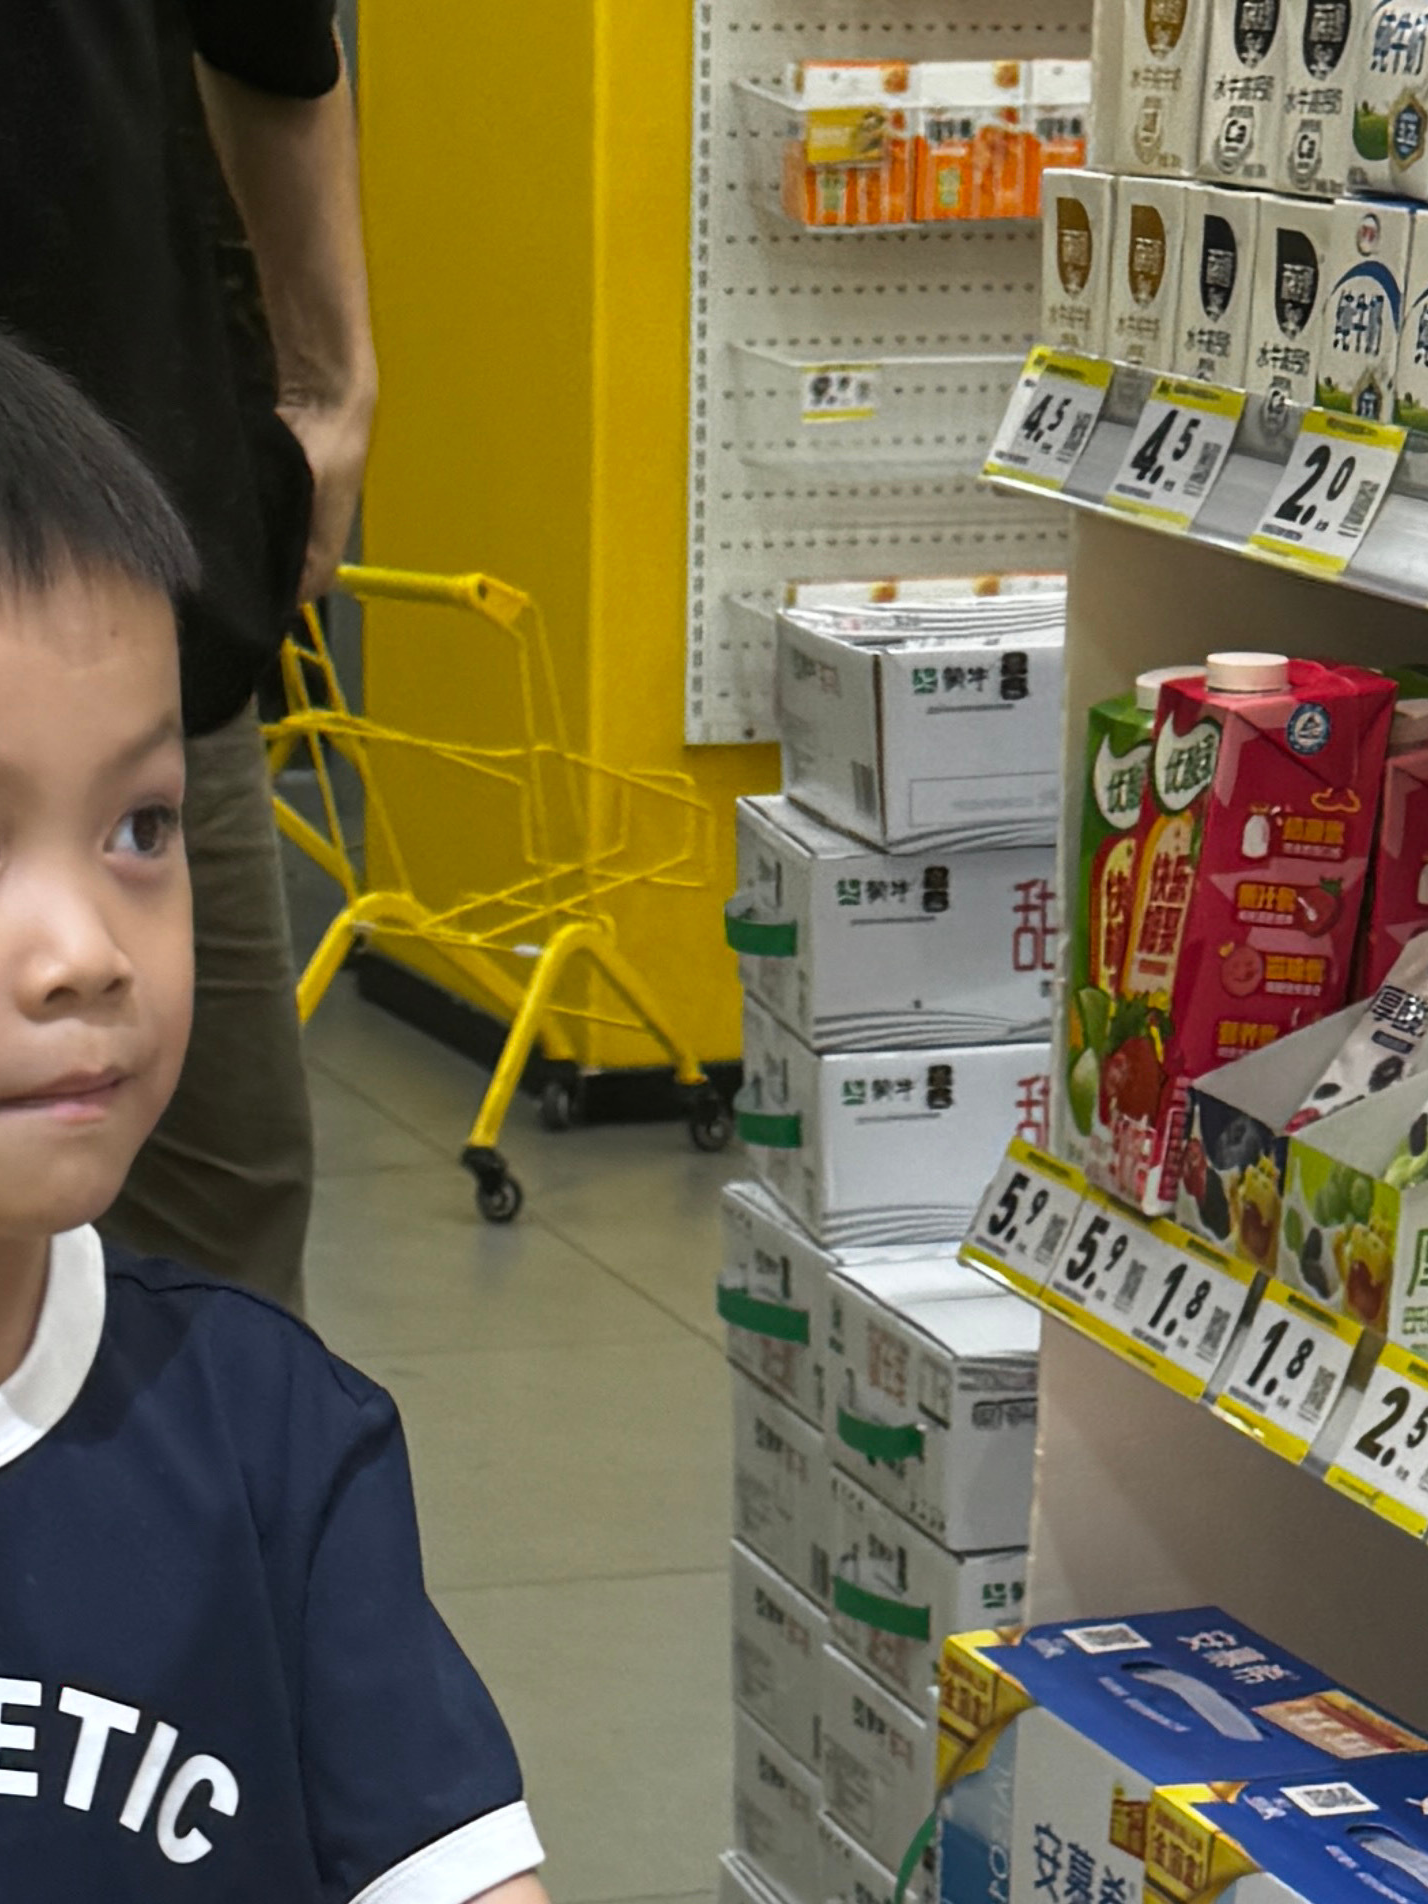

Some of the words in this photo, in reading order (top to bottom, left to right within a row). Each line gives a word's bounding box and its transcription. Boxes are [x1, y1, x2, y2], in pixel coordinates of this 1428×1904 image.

[1131, 410, 1200, 484] 4.5
[1275, 446, 1356, 524] 2.0
[989, 1172, 1050, 1243] 5.9
[1065, 1216, 1128, 1290] 5.9
[1148, 1263, 1211, 1337] 1.8
[1246, 1320, 1314, 1396] 1.8
